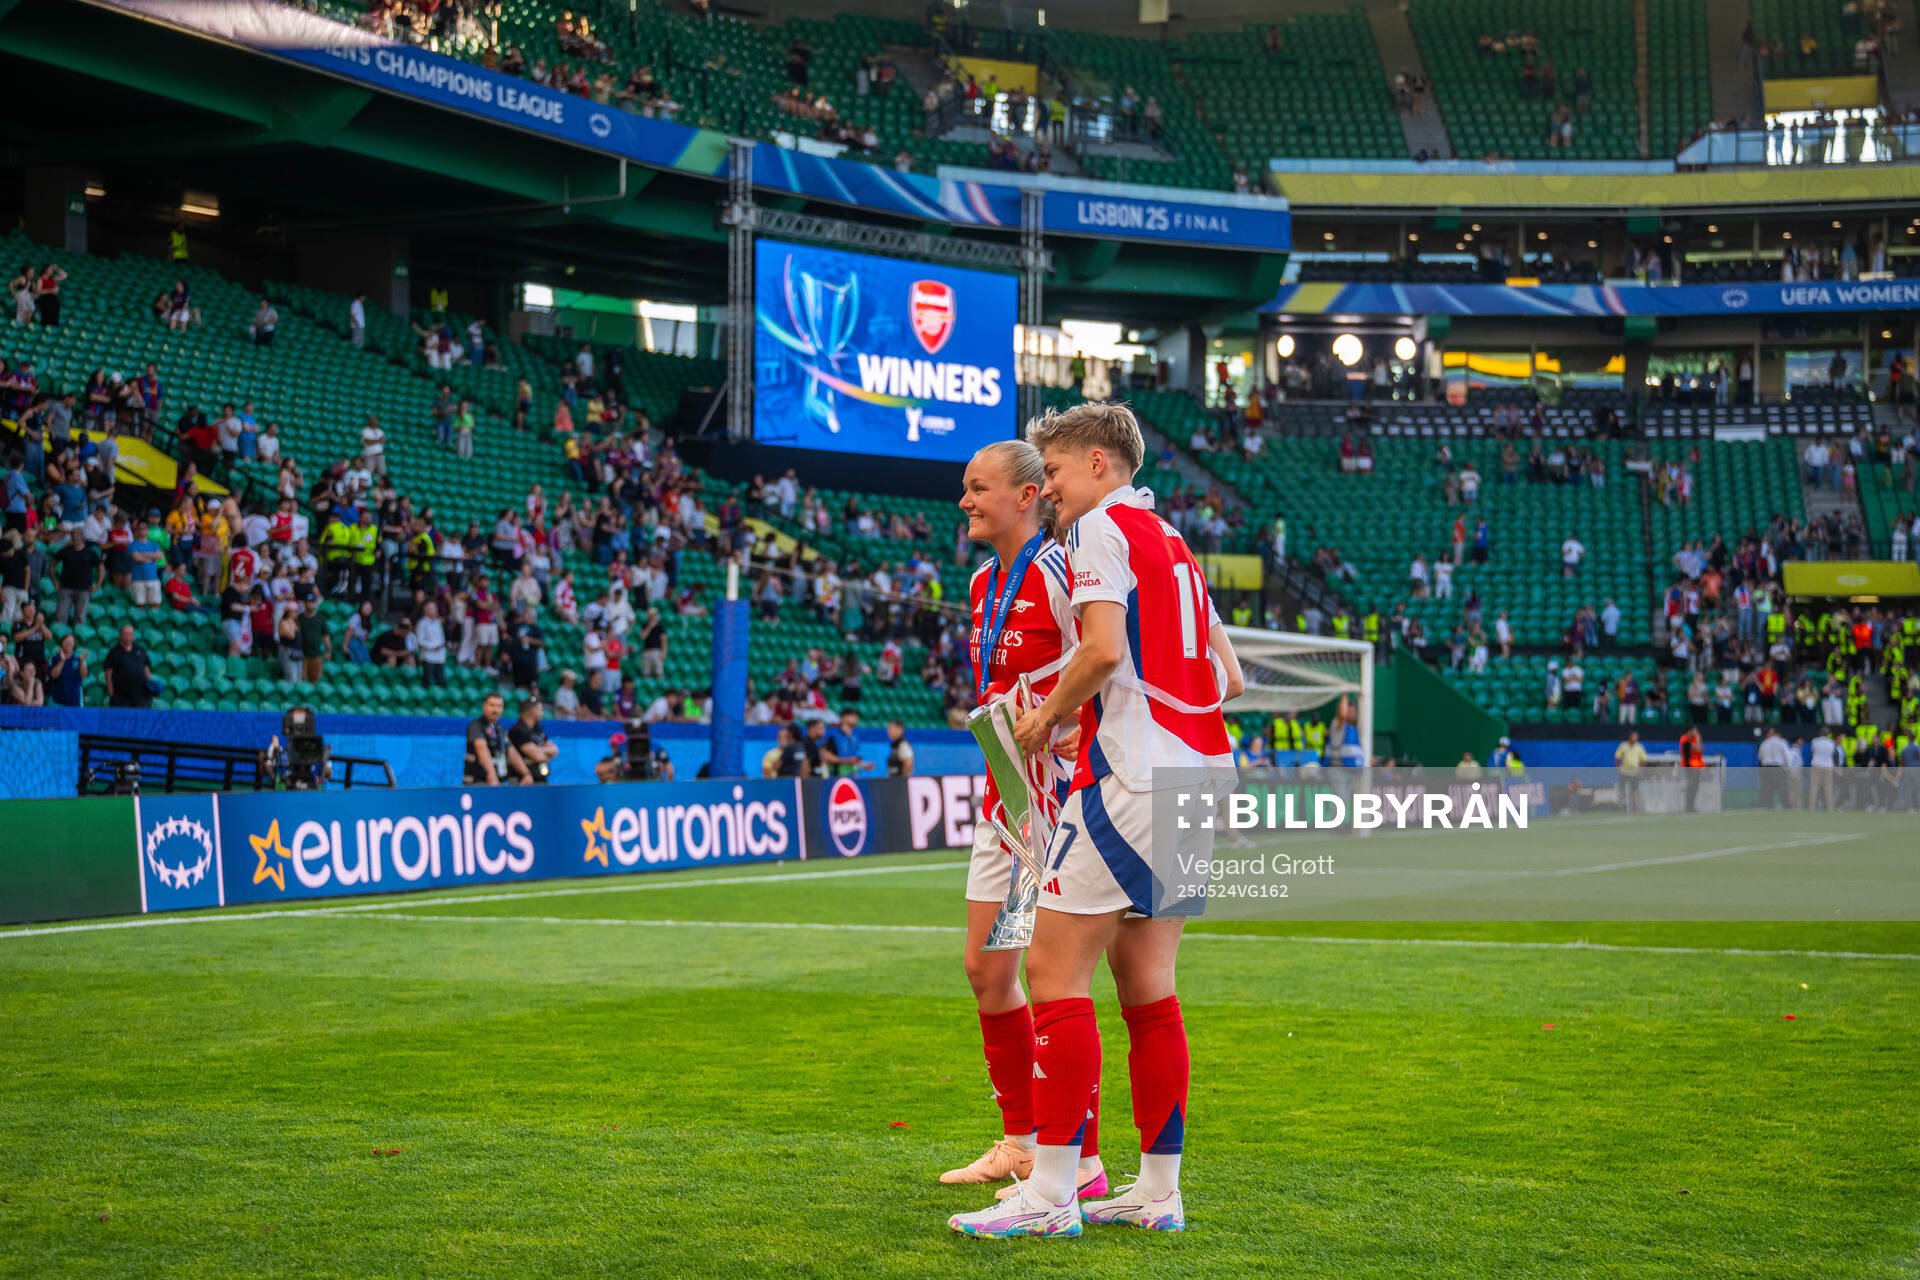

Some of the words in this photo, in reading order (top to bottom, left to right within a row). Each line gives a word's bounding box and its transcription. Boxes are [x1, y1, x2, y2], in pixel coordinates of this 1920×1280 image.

[375, 49, 493, 103] CHAMPIONS
[497, 85, 564, 124] LEAGUE
[1078, 200, 1144, 229] LISBON
[1145, 206, 1169, 231] 25
[1173, 212, 1230, 233] FINAL
[1781, 286, 1832, 306] UEFA
[858, 354, 1001, 407] WINNERS
[292, 793, 534, 888] euronics
[611, 785, 789, 866] euronics
